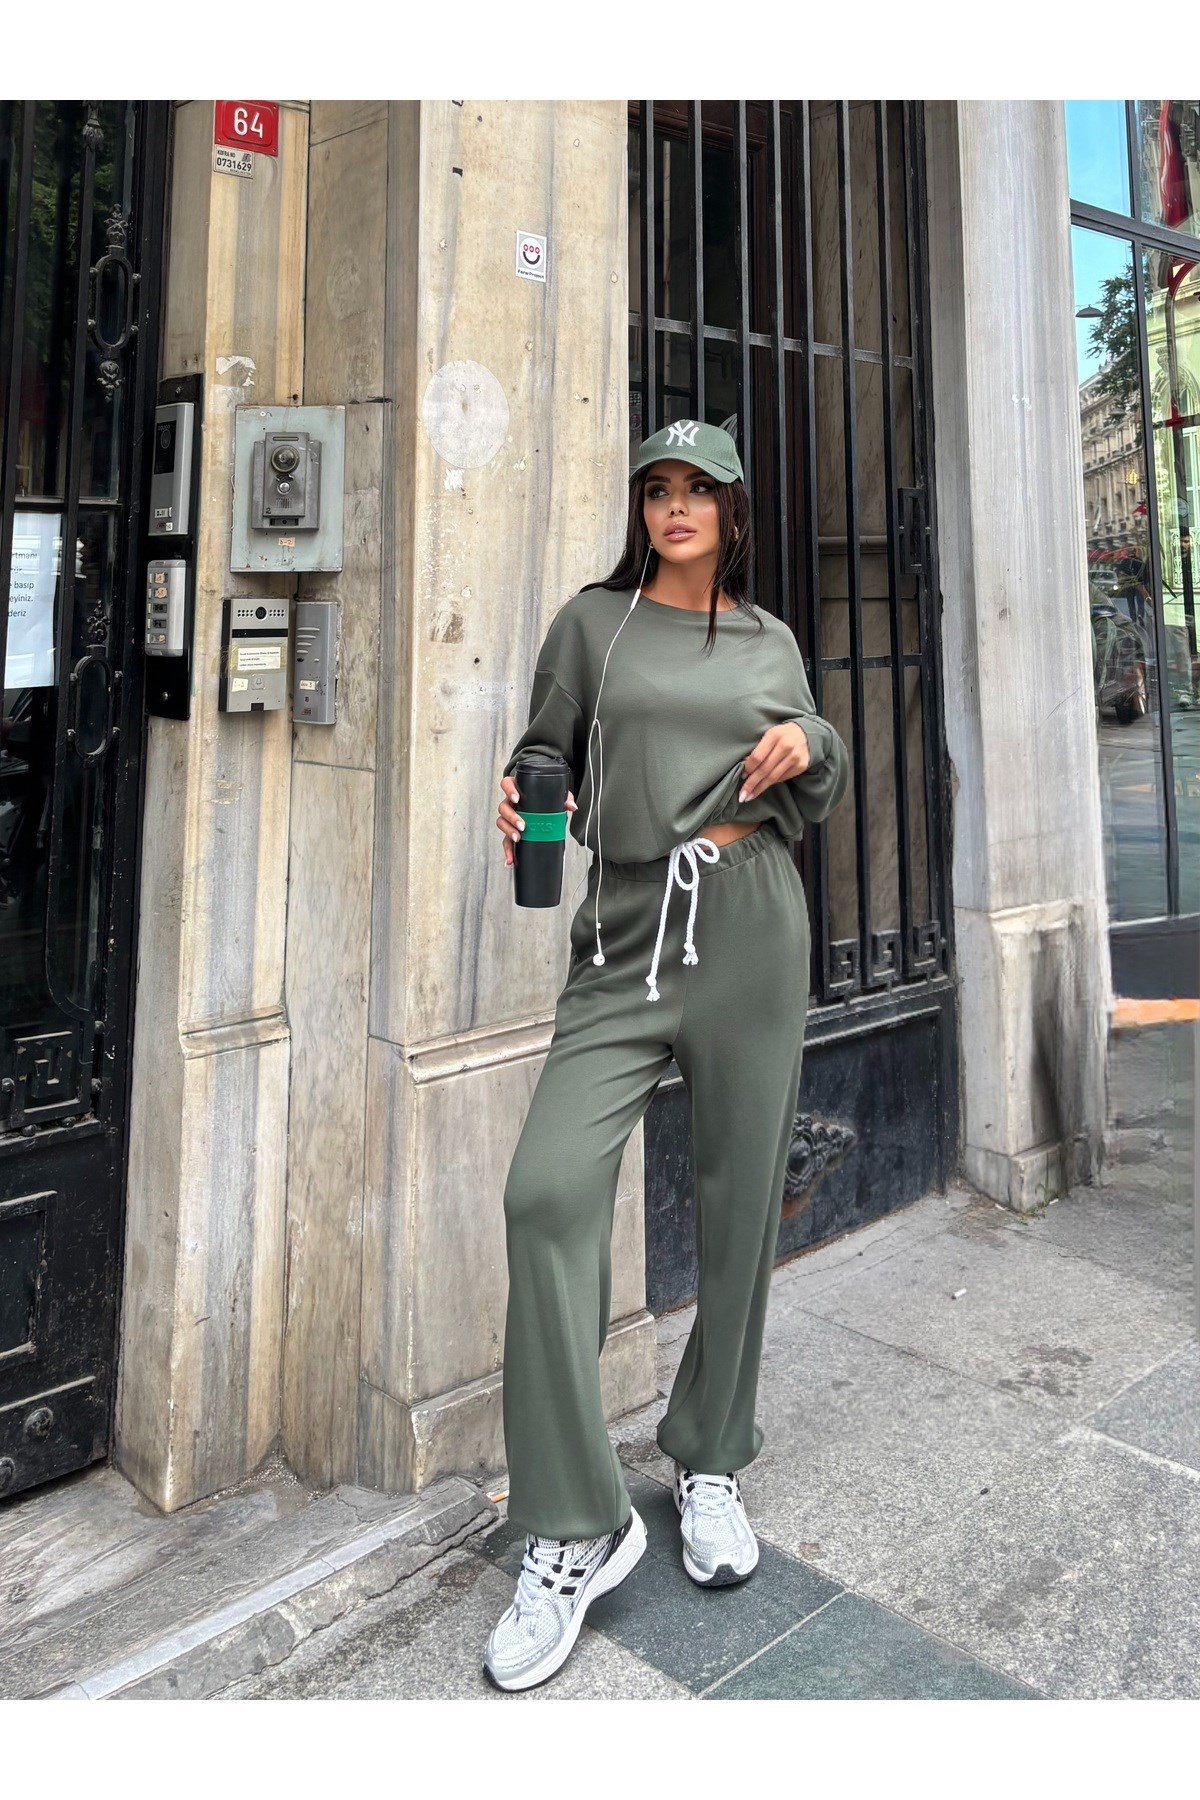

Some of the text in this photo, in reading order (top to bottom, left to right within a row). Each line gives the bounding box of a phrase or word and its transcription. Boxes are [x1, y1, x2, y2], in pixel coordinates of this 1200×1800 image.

[234, 107, 263, 138] 64
[216, 157, 252, 172] 0731629
[665, 420, 700, 447] NY
